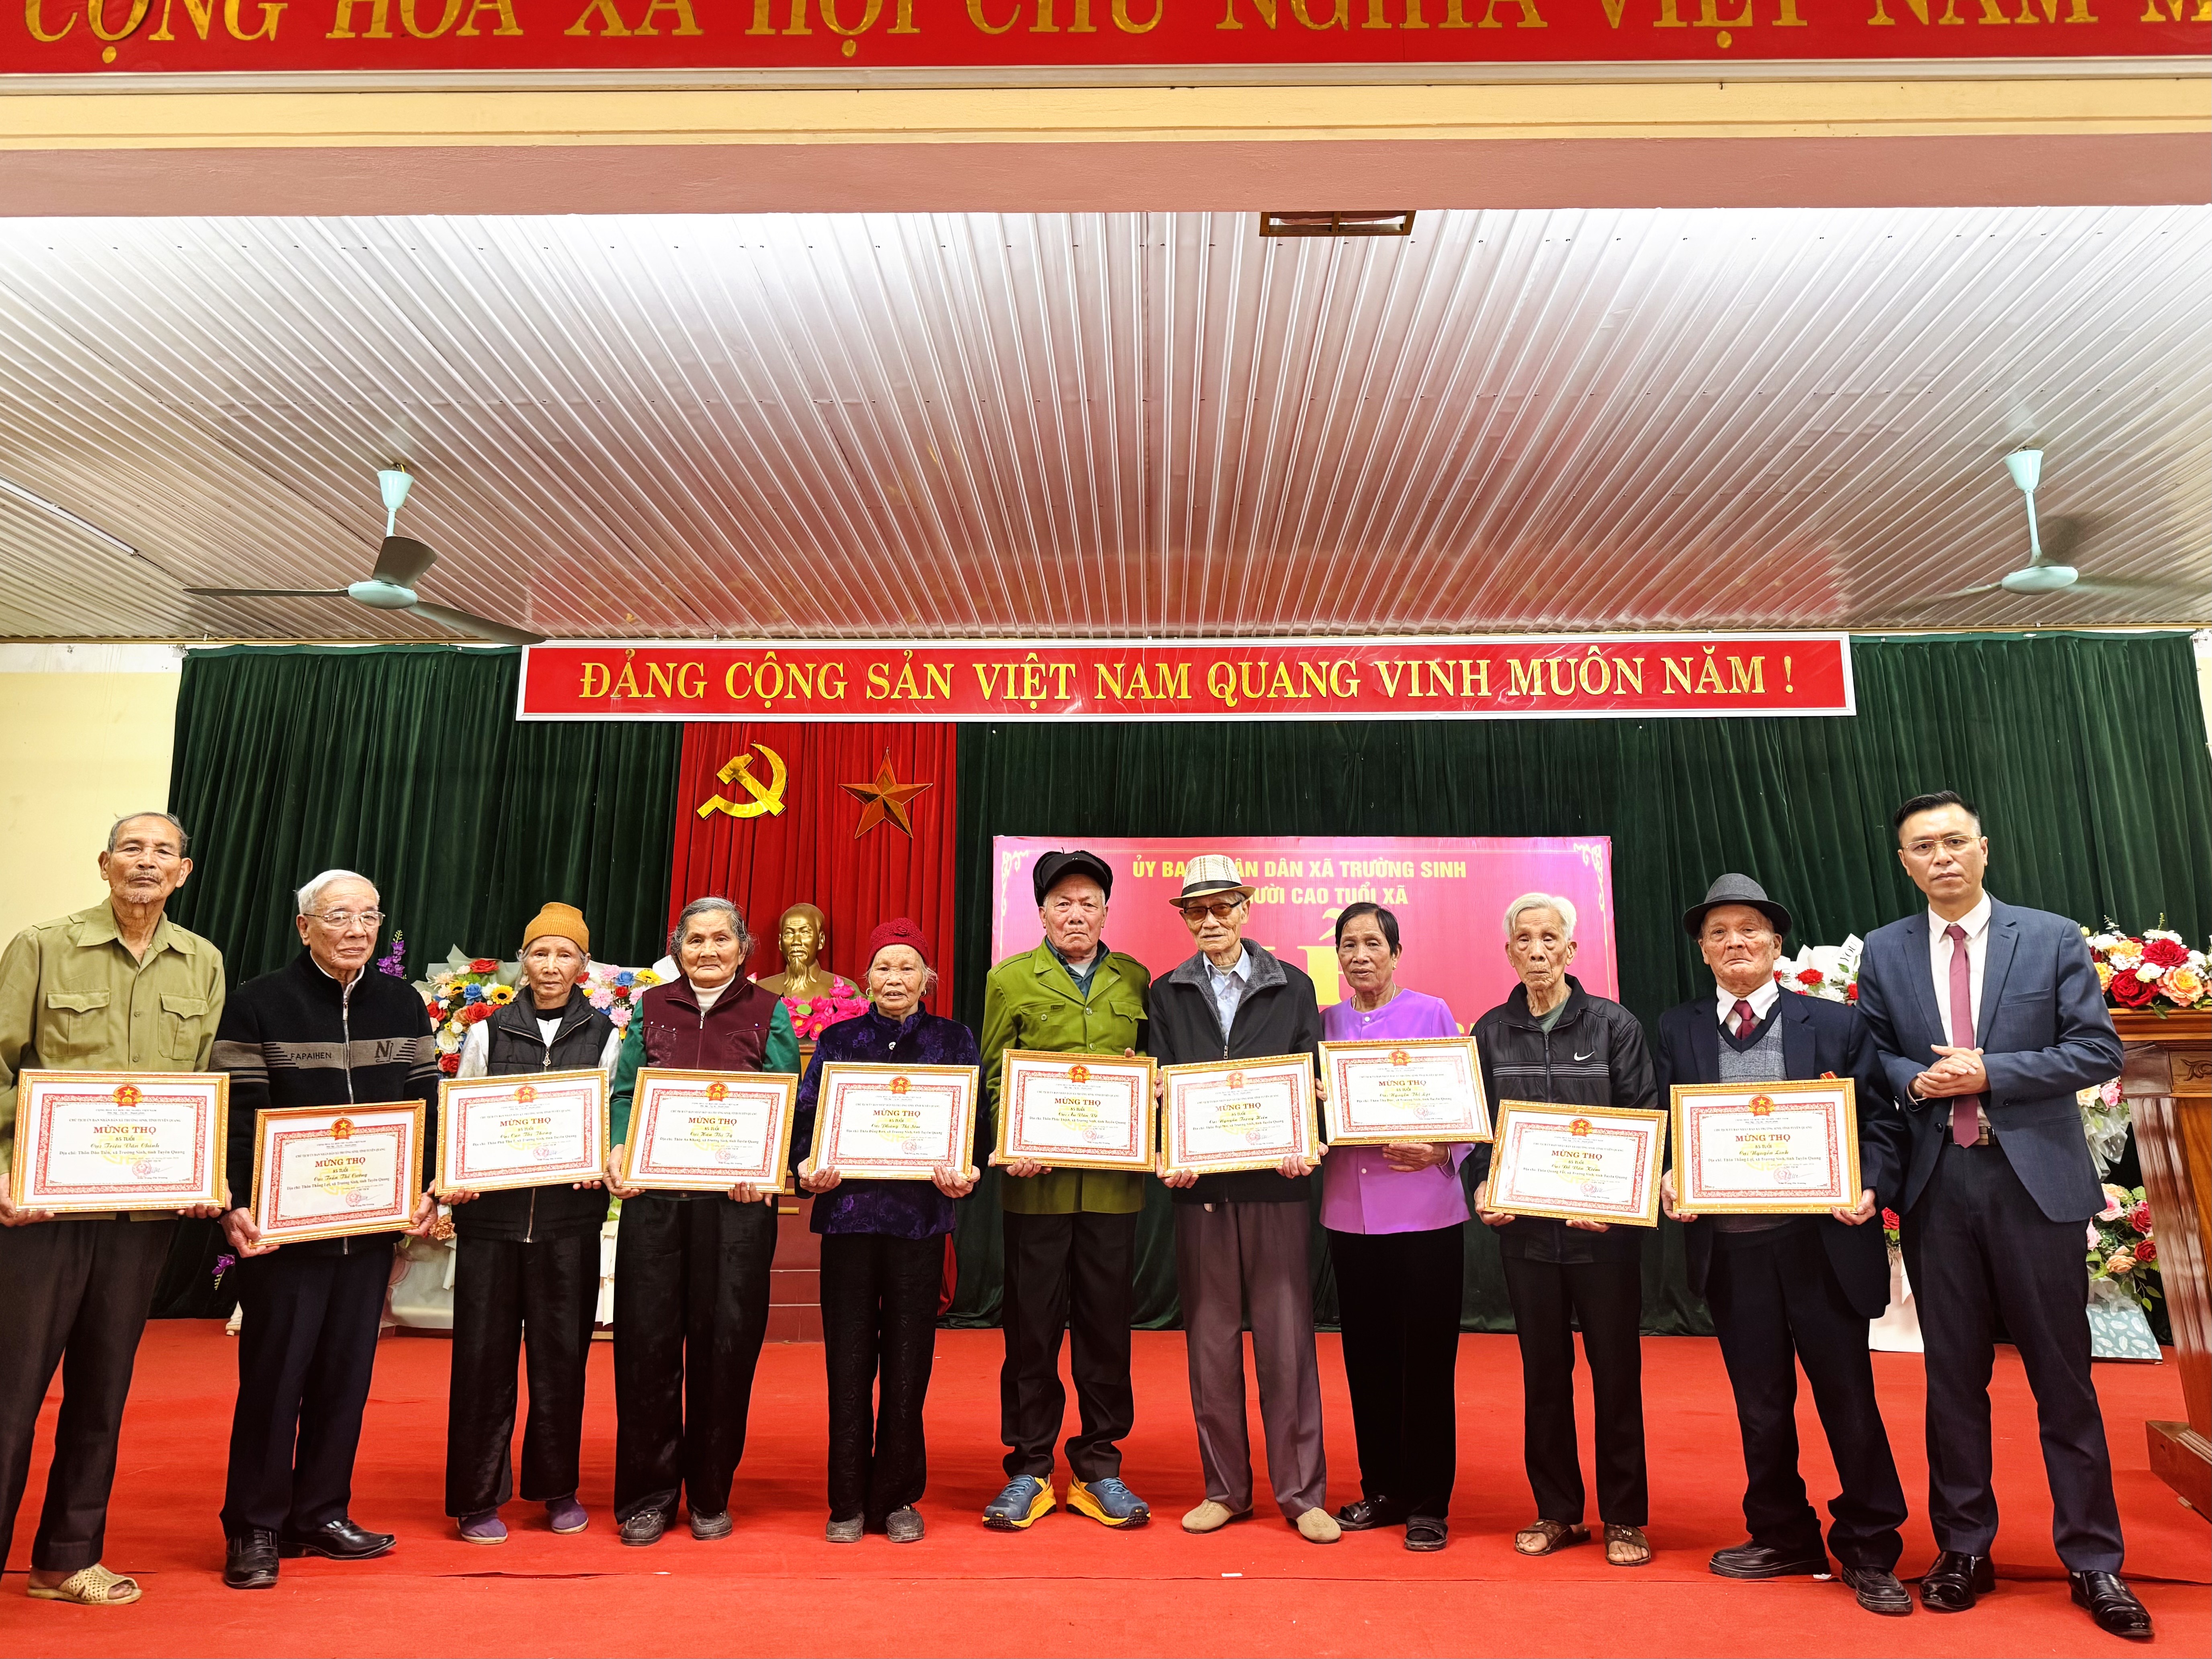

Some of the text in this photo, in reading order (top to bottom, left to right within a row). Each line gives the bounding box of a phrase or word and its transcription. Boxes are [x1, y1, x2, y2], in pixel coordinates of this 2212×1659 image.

[579, 646, 1793, 709] ĐẢNG CỘNG SẢN VIỆT NAM QUANG VINH MUÔN NĂM !
[1133, 854, 1466, 878] ỦY BA ÂN DÂN XÃ TRƯỜNG SINH
[1249, 881, 1408, 904] ƯỜI CAO TUỔI XÃ
[1840, 941, 1857, 961] YOU
[291, 1052, 331, 1060] FAPAIHEN
[1215, 1104, 1241, 1112] MỪNG
[902, 1110, 921, 1118] THỌ
[500, 1119, 528, 1127] MỪNG
[718, 1118, 737, 1126] THỌ
[93, 1125, 156, 1135] MỪNG THỌ
[1735, 1133, 1766, 1142] MỪNG
[1551, 1150, 1602, 1161] MỪNG THỌ
[315, 1157, 366, 1167] MỪNG THỌ
